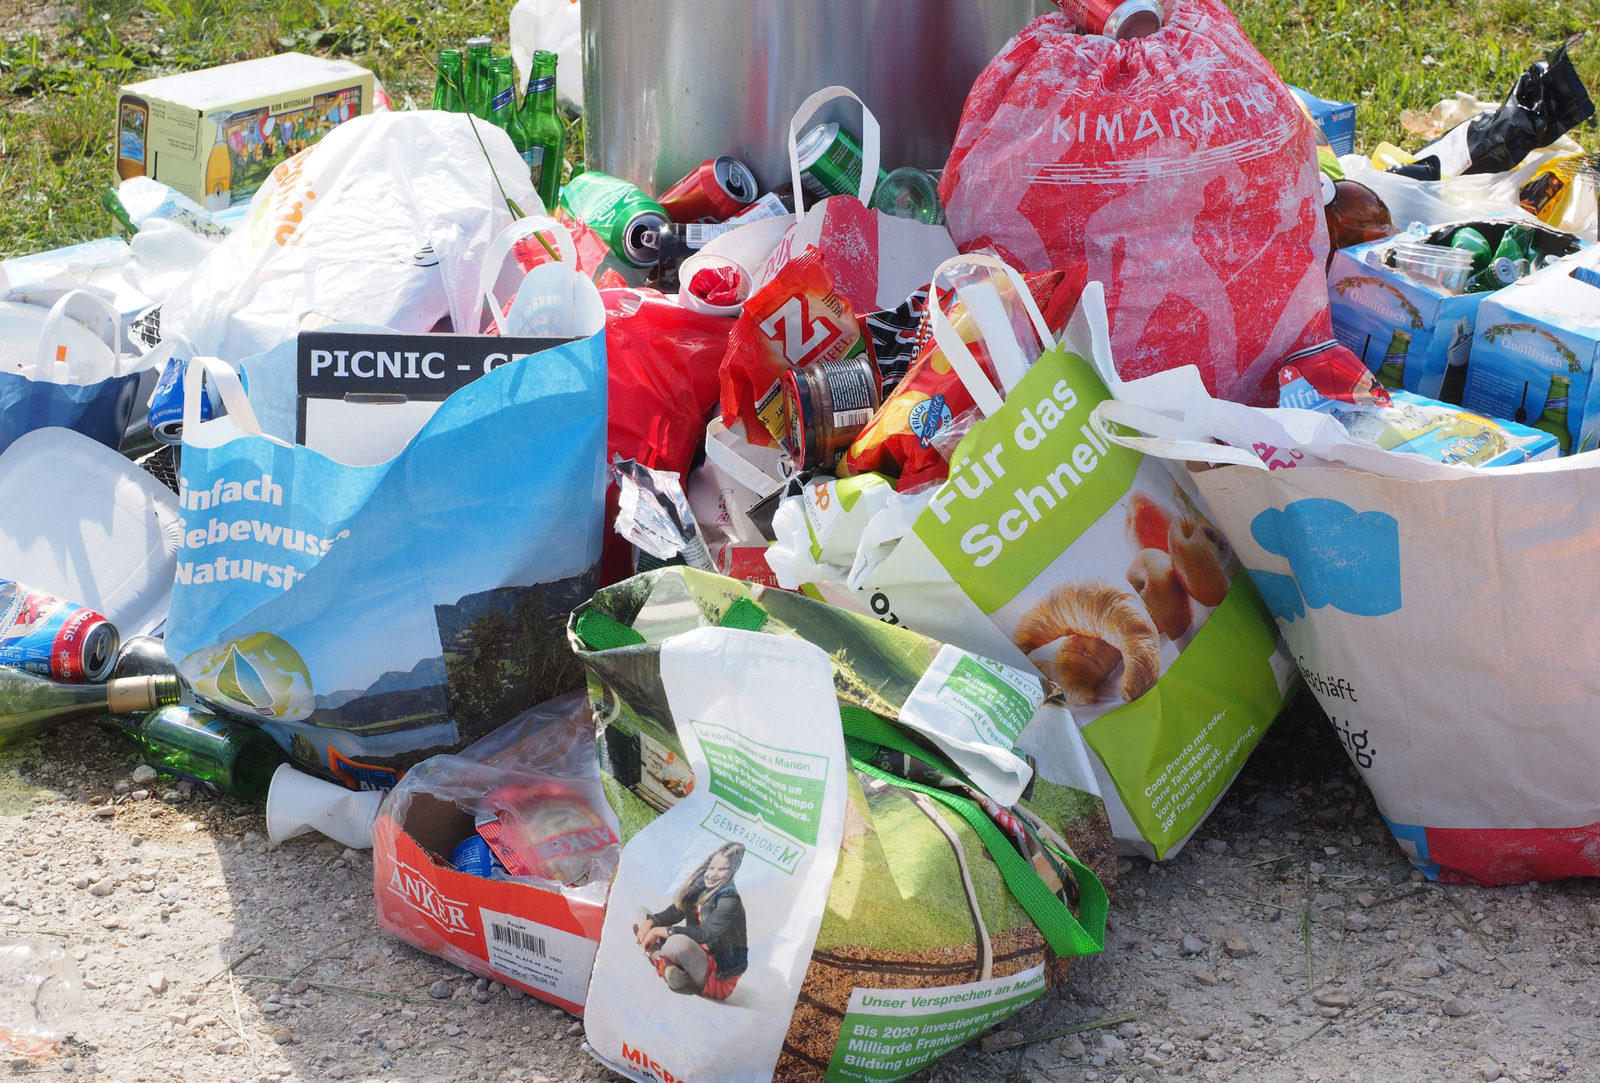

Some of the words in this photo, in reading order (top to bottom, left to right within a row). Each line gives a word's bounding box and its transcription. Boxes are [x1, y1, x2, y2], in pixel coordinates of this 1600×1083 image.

[1350, 290, 1407, 323] Quöllfrisch
[310, 349, 445, 379] PICNIC
[1501, 338, 1563, 368] Quöllfrisch
[914, 404, 926, 430] FRISCH
[928, 443, 1006, 525] Für
[1014, 379, 1078, 451] das
[180, 474, 283, 511] infach
[775, 757, 811, 771] Manon
[1144, 772, 1168, 797] Coop
[1165, 744, 1193, 774] Pronto
[1193, 728, 1208, 746] mit
[1207, 709, 1227, 731] oder
[789, 786, 802, 795] un
[1151, 785, 1171, 809] ohne
[1170, 743, 1212, 787] Tankstelle.
[1155, 802, 1171, 820] Von
[1170, 783, 1191, 804] früh
[1189, 769, 1203, 785] bis
[1203, 747, 1222, 772] spät.
[1160, 812, 1177, 833] 365
[1176, 792, 1196, 814] Tage
[1195, 780, 1207, 795] im
[1206, 760, 1225, 782] Jahr
[1224, 724, 1258, 764] geöffnet.
[784, 795, 814, 810] tempo
[712, 814, 782, 855] GENERAZIONE
[388, 866, 470, 931] ANKER
[861, 995, 907, 1009] Unser
[911, 987, 992, 1007] Versprechen
[995, 985, 1010, 995] an
[853, 1024, 878, 1038] Bis
[883, 1026, 919, 1039] 2020
[921, 1012, 988, 1035] investieren
[991, 1006, 1010, 1018] wir
[848, 1038, 913, 1055] Milliarde
[916, 1032, 965, 1051] Franken
[967, 1025, 979, 1037] in
[844, 1054, 903, 1071] Bildung
[905, 1054, 930, 1067] und
